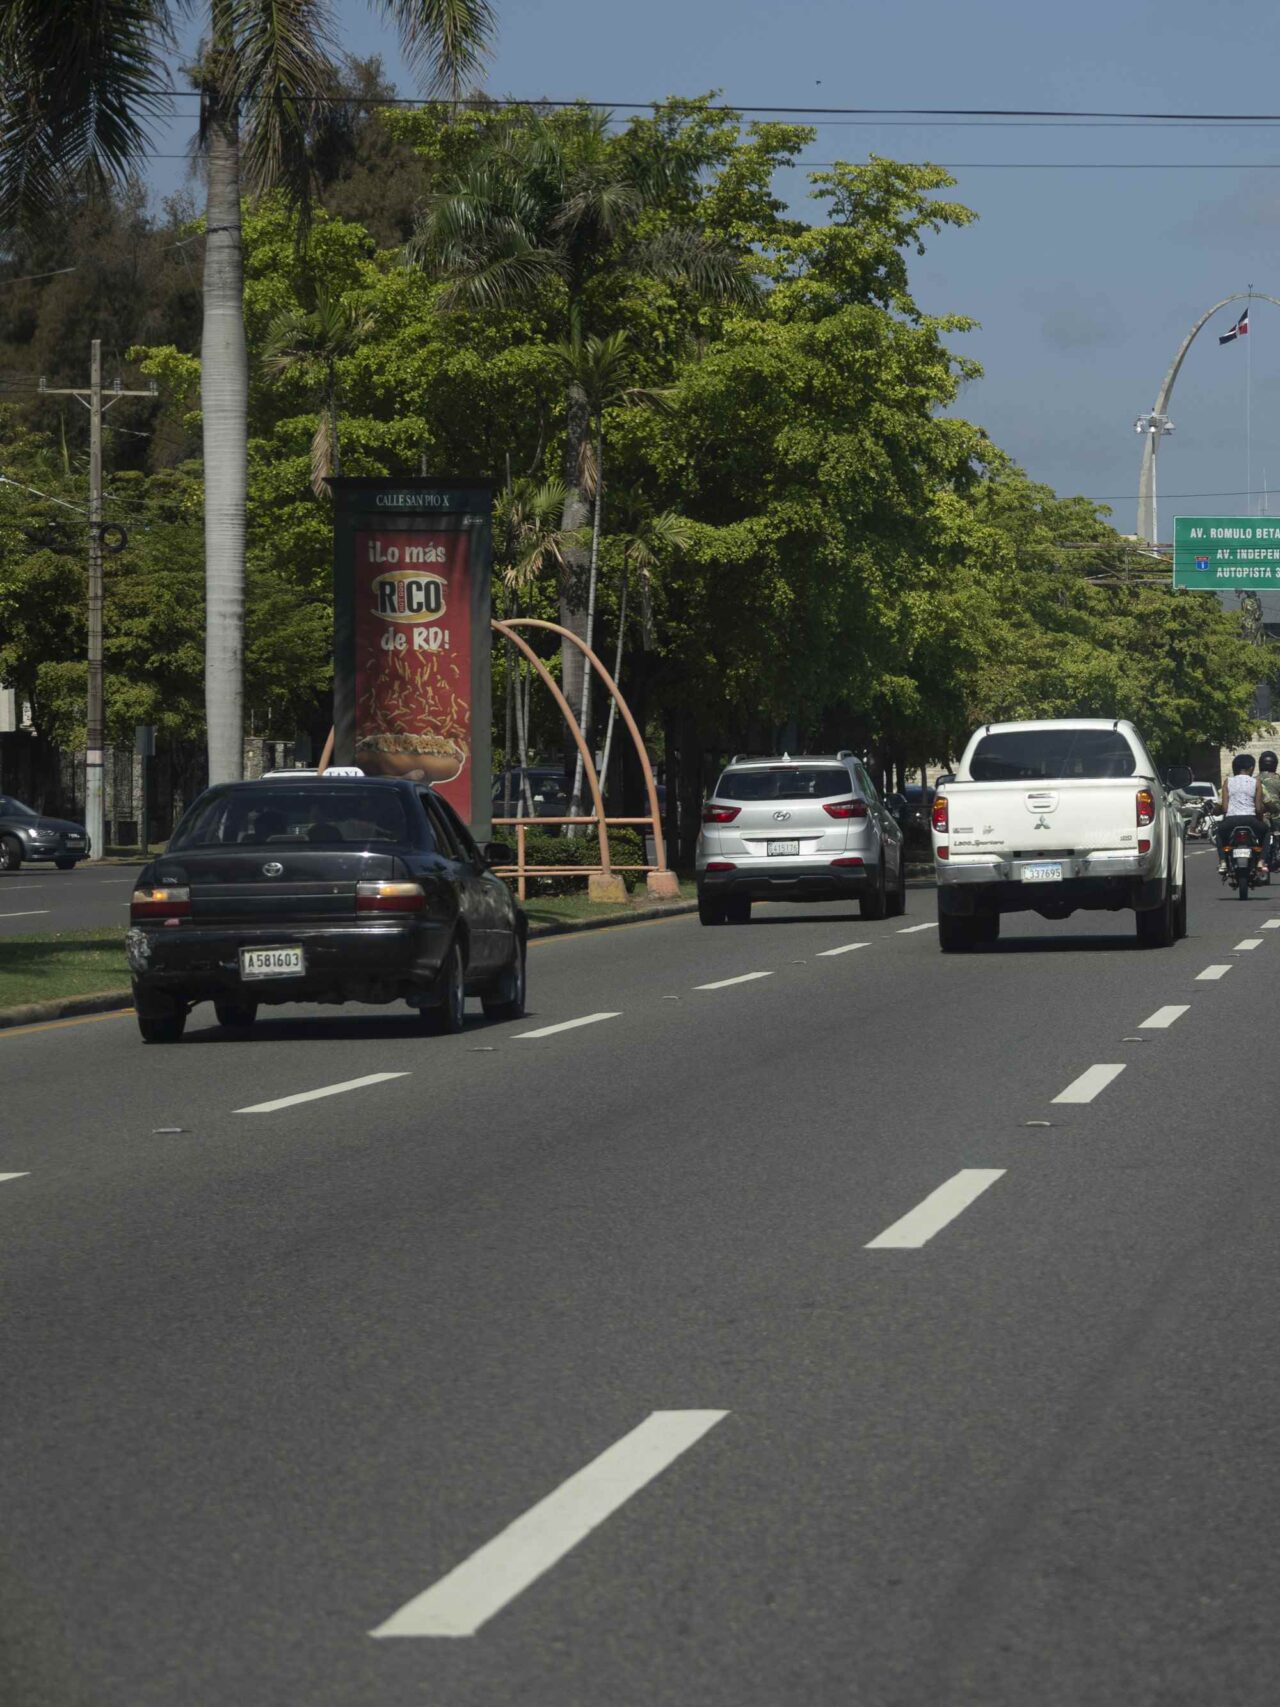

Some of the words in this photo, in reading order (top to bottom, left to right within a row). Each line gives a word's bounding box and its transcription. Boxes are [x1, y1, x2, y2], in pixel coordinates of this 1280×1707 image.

[376, 494, 404, 506] CALLE
[406, 494, 424, 506] SAN
[425, 495, 441, 506] PIO
[442, 495, 449, 507] X
[1190, 528, 1206, 538] AV.
[1210, 528, 1252, 538] ROMULO
[405, 542, 446, 563] más
[1217, 549, 1233, 560] AV.
[1217, 567, 1271, 578] AUTOPISTA
[381, 627, 407, 650] de
[413, 627, 450, 651] RD!
[248, 953, 299, 968] A581603
